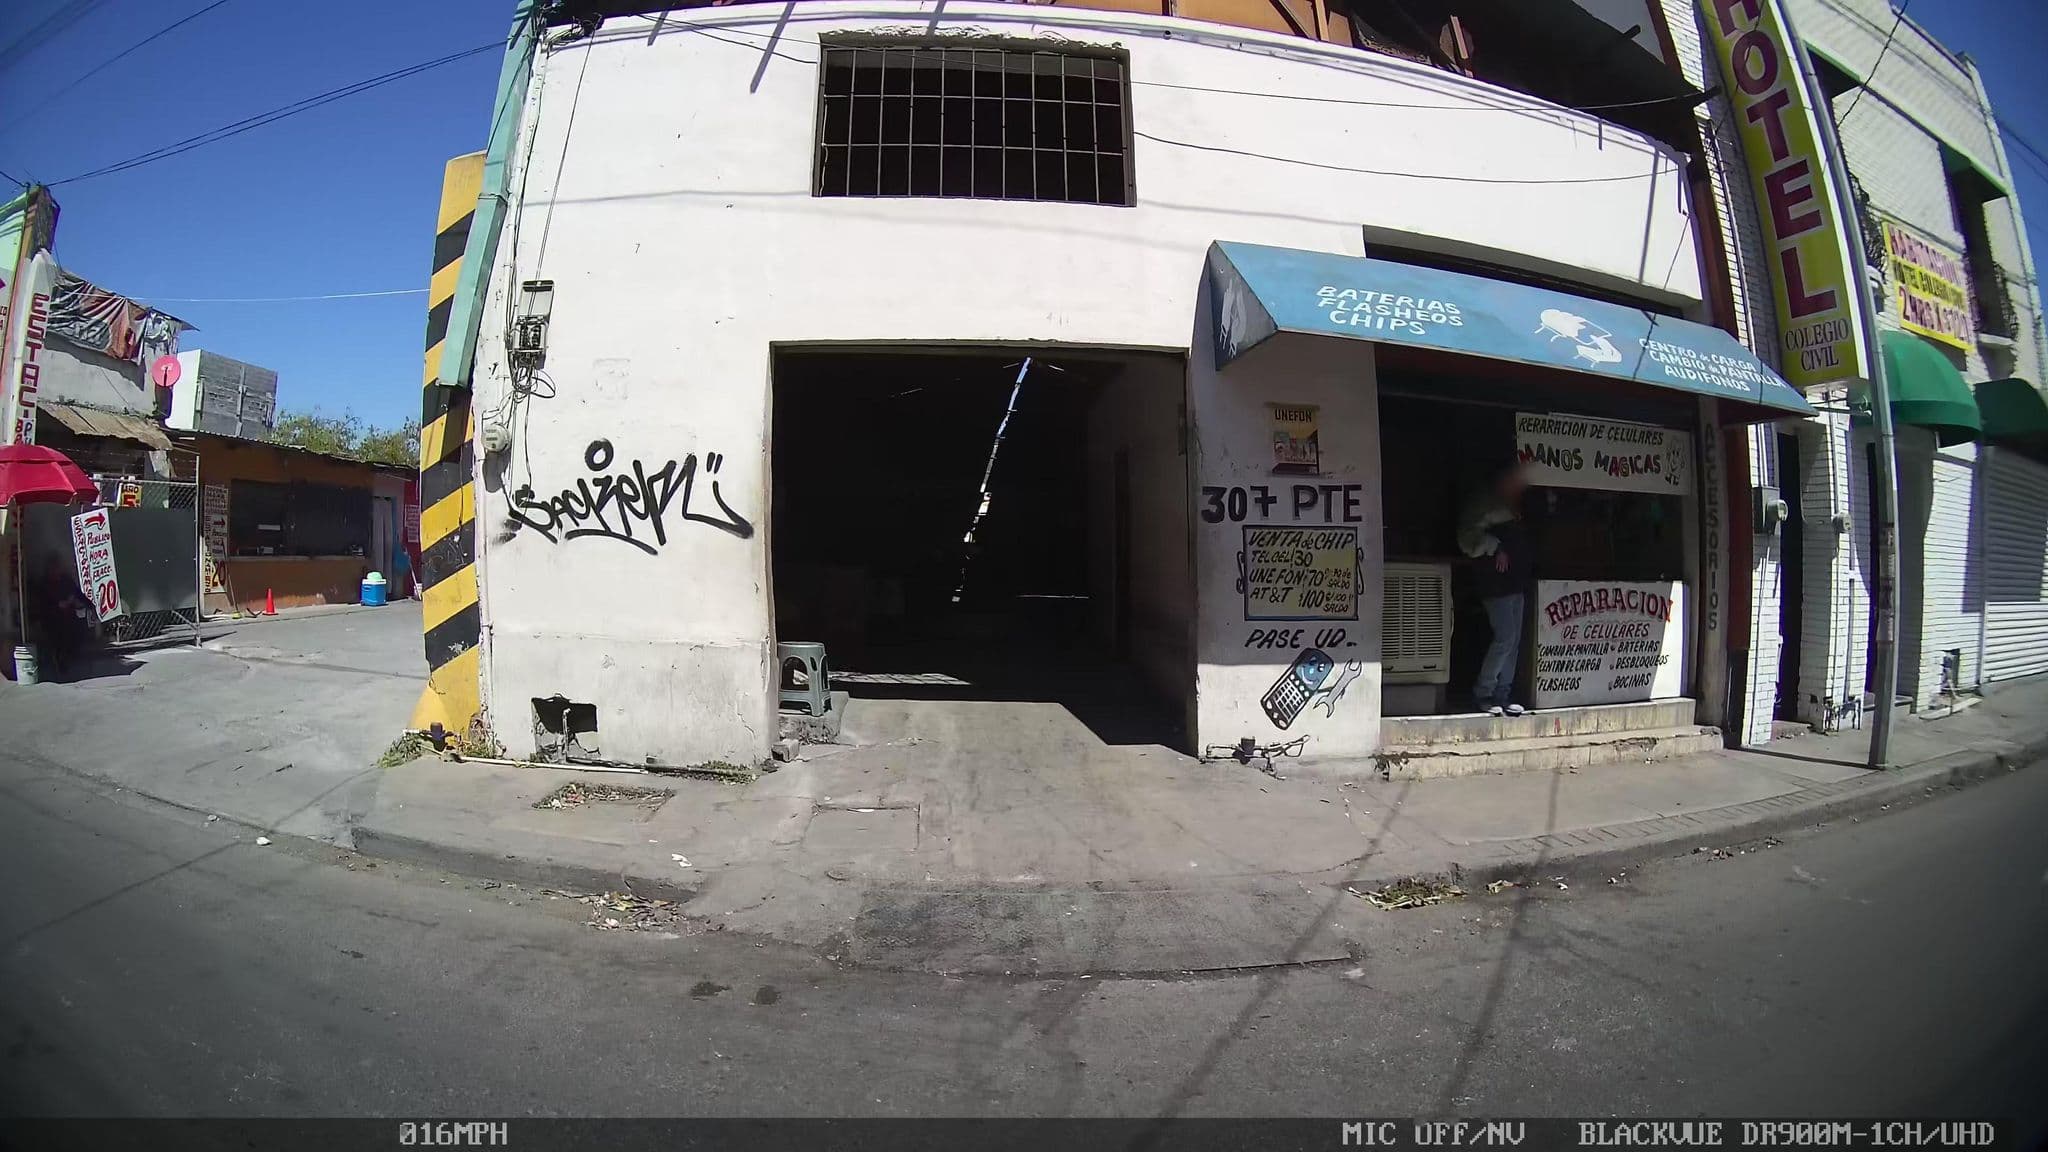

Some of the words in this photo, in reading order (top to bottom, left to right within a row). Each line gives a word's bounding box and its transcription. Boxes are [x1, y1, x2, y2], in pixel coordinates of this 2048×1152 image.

[1713, 0, 1837, 321] HOTEL
[1316, 286, 1461, 315] BATERIAS
[1317, 297, 1464, 327] FLASHEOS
[1329, 310, 1426, 335] CHIPS
[1784, 318, 1850, 354] COLEGIO
[1638, 338, 1697, 360] CENTRO
[1711, 353, 1757, 373] CARGA
[1799, 346, 1840, 373] CIVIL
[1649, 350, 1706, 370] CAMBIO
[1718, 365, 1788, 389] PANTALLA
[1664, 364, 1752, 392] AUDIFONOS
[1274, 407, 1313, 423] UNEFON
[1589, 423, 1604, 440] DE
[1607, 426, 1664, 446] CELULARES
[1518, 442, 1584, 472] MANOS
[1594, 449, 1662, 477] MAGICAS
[1201, 485, 1278, 523] 307
[1293, 484, 1363, 523] PTE
[1703, 423, 1719, 631] ACCESORIOS
[1248, 530, 1304, 548] VENTA
[1314, 532, 1355, 551] CHIP
[90, 549, 108, 560] HORA
[1250, 587, 1294, 603] AT&T
[1545, 587, 1673, 626] REPARACION
[1244, 629, 1305, 649] PASE
[1563, 625, 1579, 640] DE
[1584, 623, 1650, 640] CELULARES
[1618, 640, 1660, 653] BATERIAS
[1575, 658, 1602, 672] CARGA
[1615, 654, 1669, 670] DESBLOQUEOS
[1538, 677, 1582, 691] FLASHEOS
[1613, 672, 1652, 689] BOCINAS
